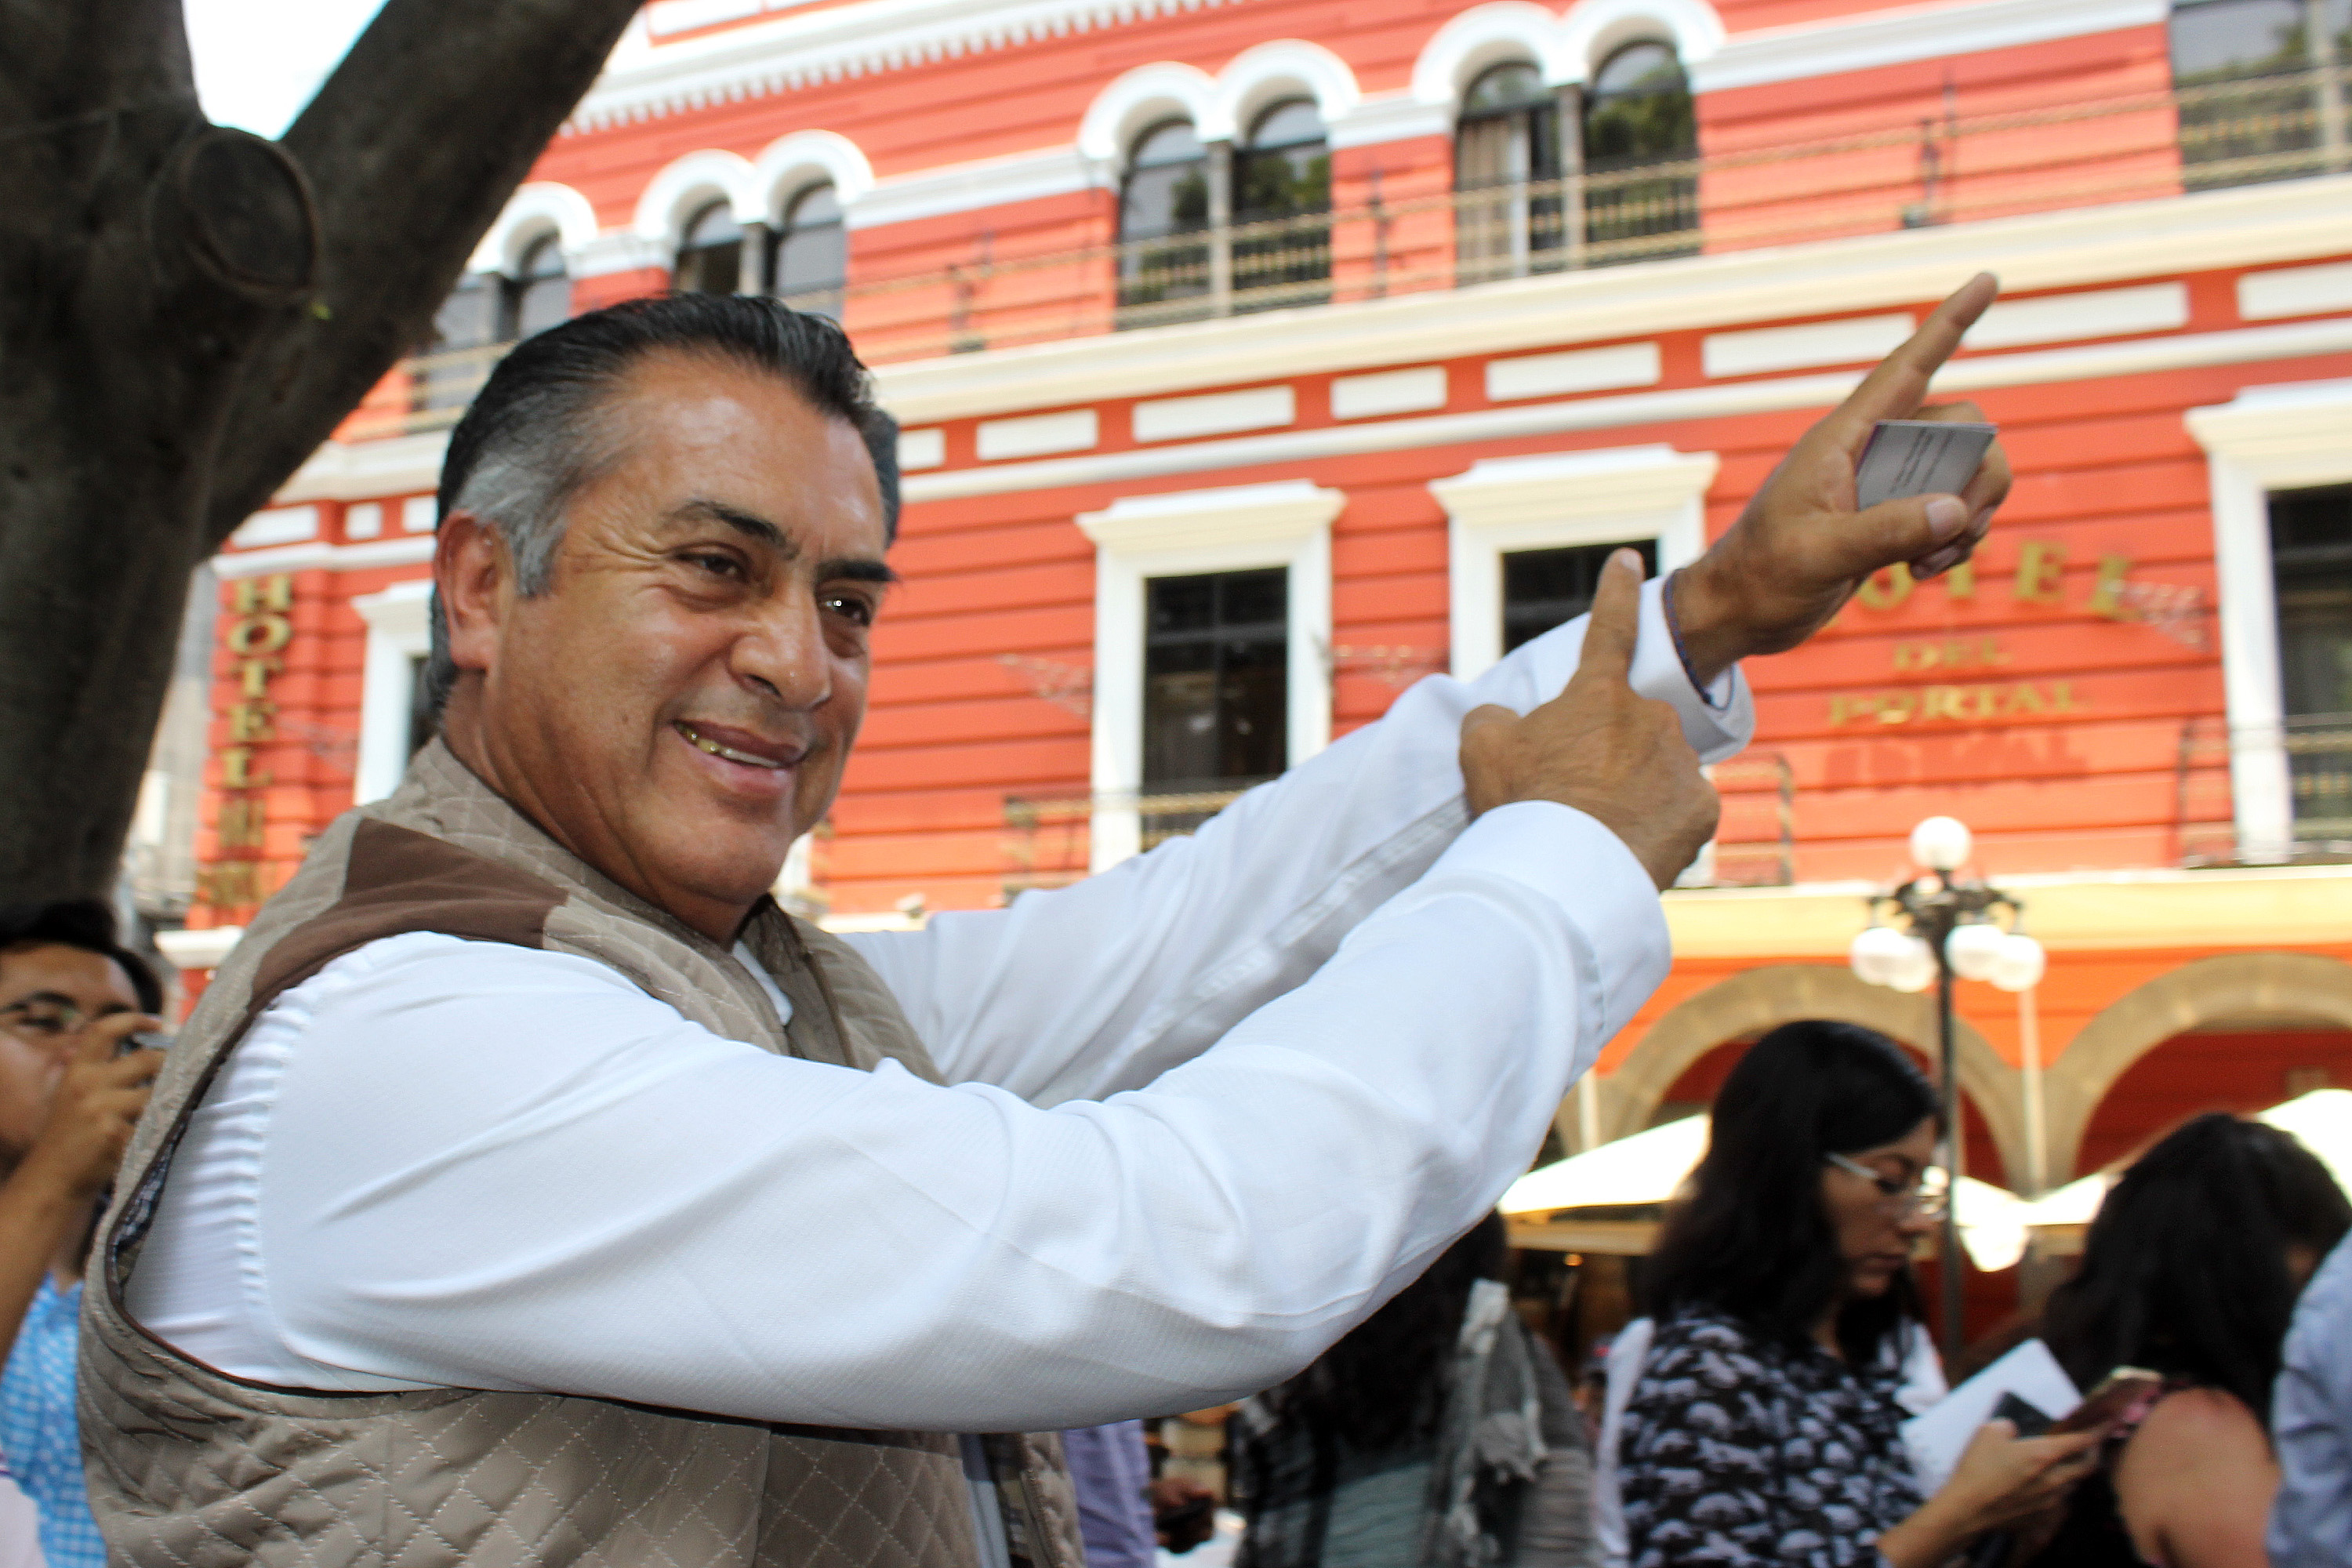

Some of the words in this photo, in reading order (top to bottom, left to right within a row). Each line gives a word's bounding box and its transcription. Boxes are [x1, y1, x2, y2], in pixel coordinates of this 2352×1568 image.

[1893, 637, 2011, 671] DEL
[223, 574, 294, 789] HOTEL
[1828, 681, 2085, 728] PORTAL
